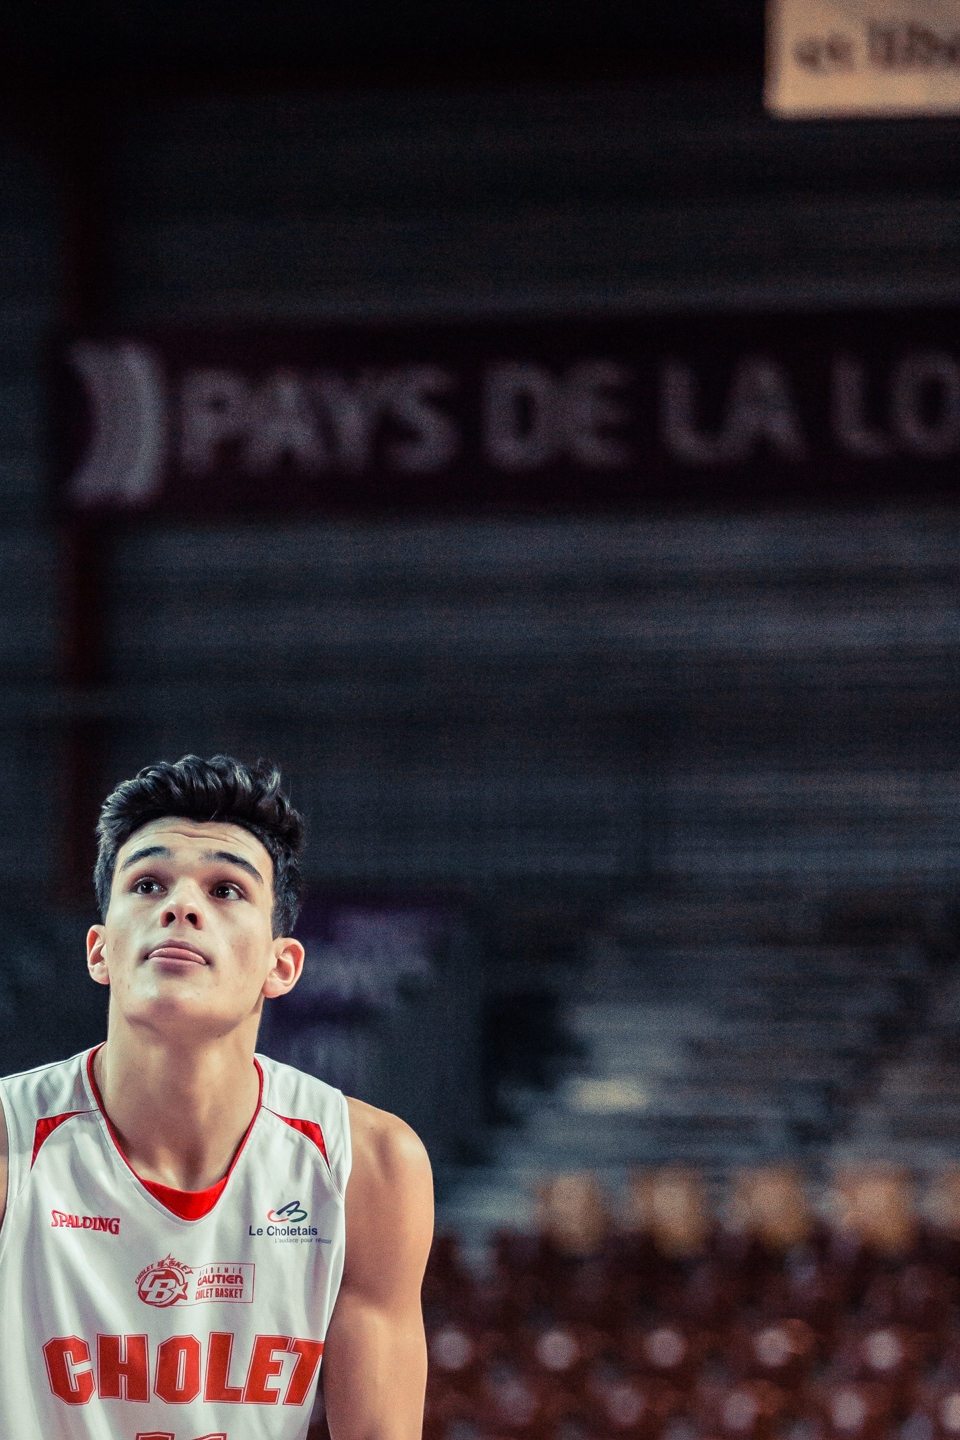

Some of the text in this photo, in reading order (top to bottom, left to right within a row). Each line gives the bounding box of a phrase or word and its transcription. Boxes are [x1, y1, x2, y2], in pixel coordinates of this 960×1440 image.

[180, 351, 960, 473] PAYS DE LA LO
[50, 1209, 121, 1235] SPALDING
[248, 1225, 318, 1236] Le Choletais
[197, 1274, 244, 1287] GAUTIER
[214, 1287, 244, 1299] BASKET
[42, 1332, 325, 1406] CHOLET
